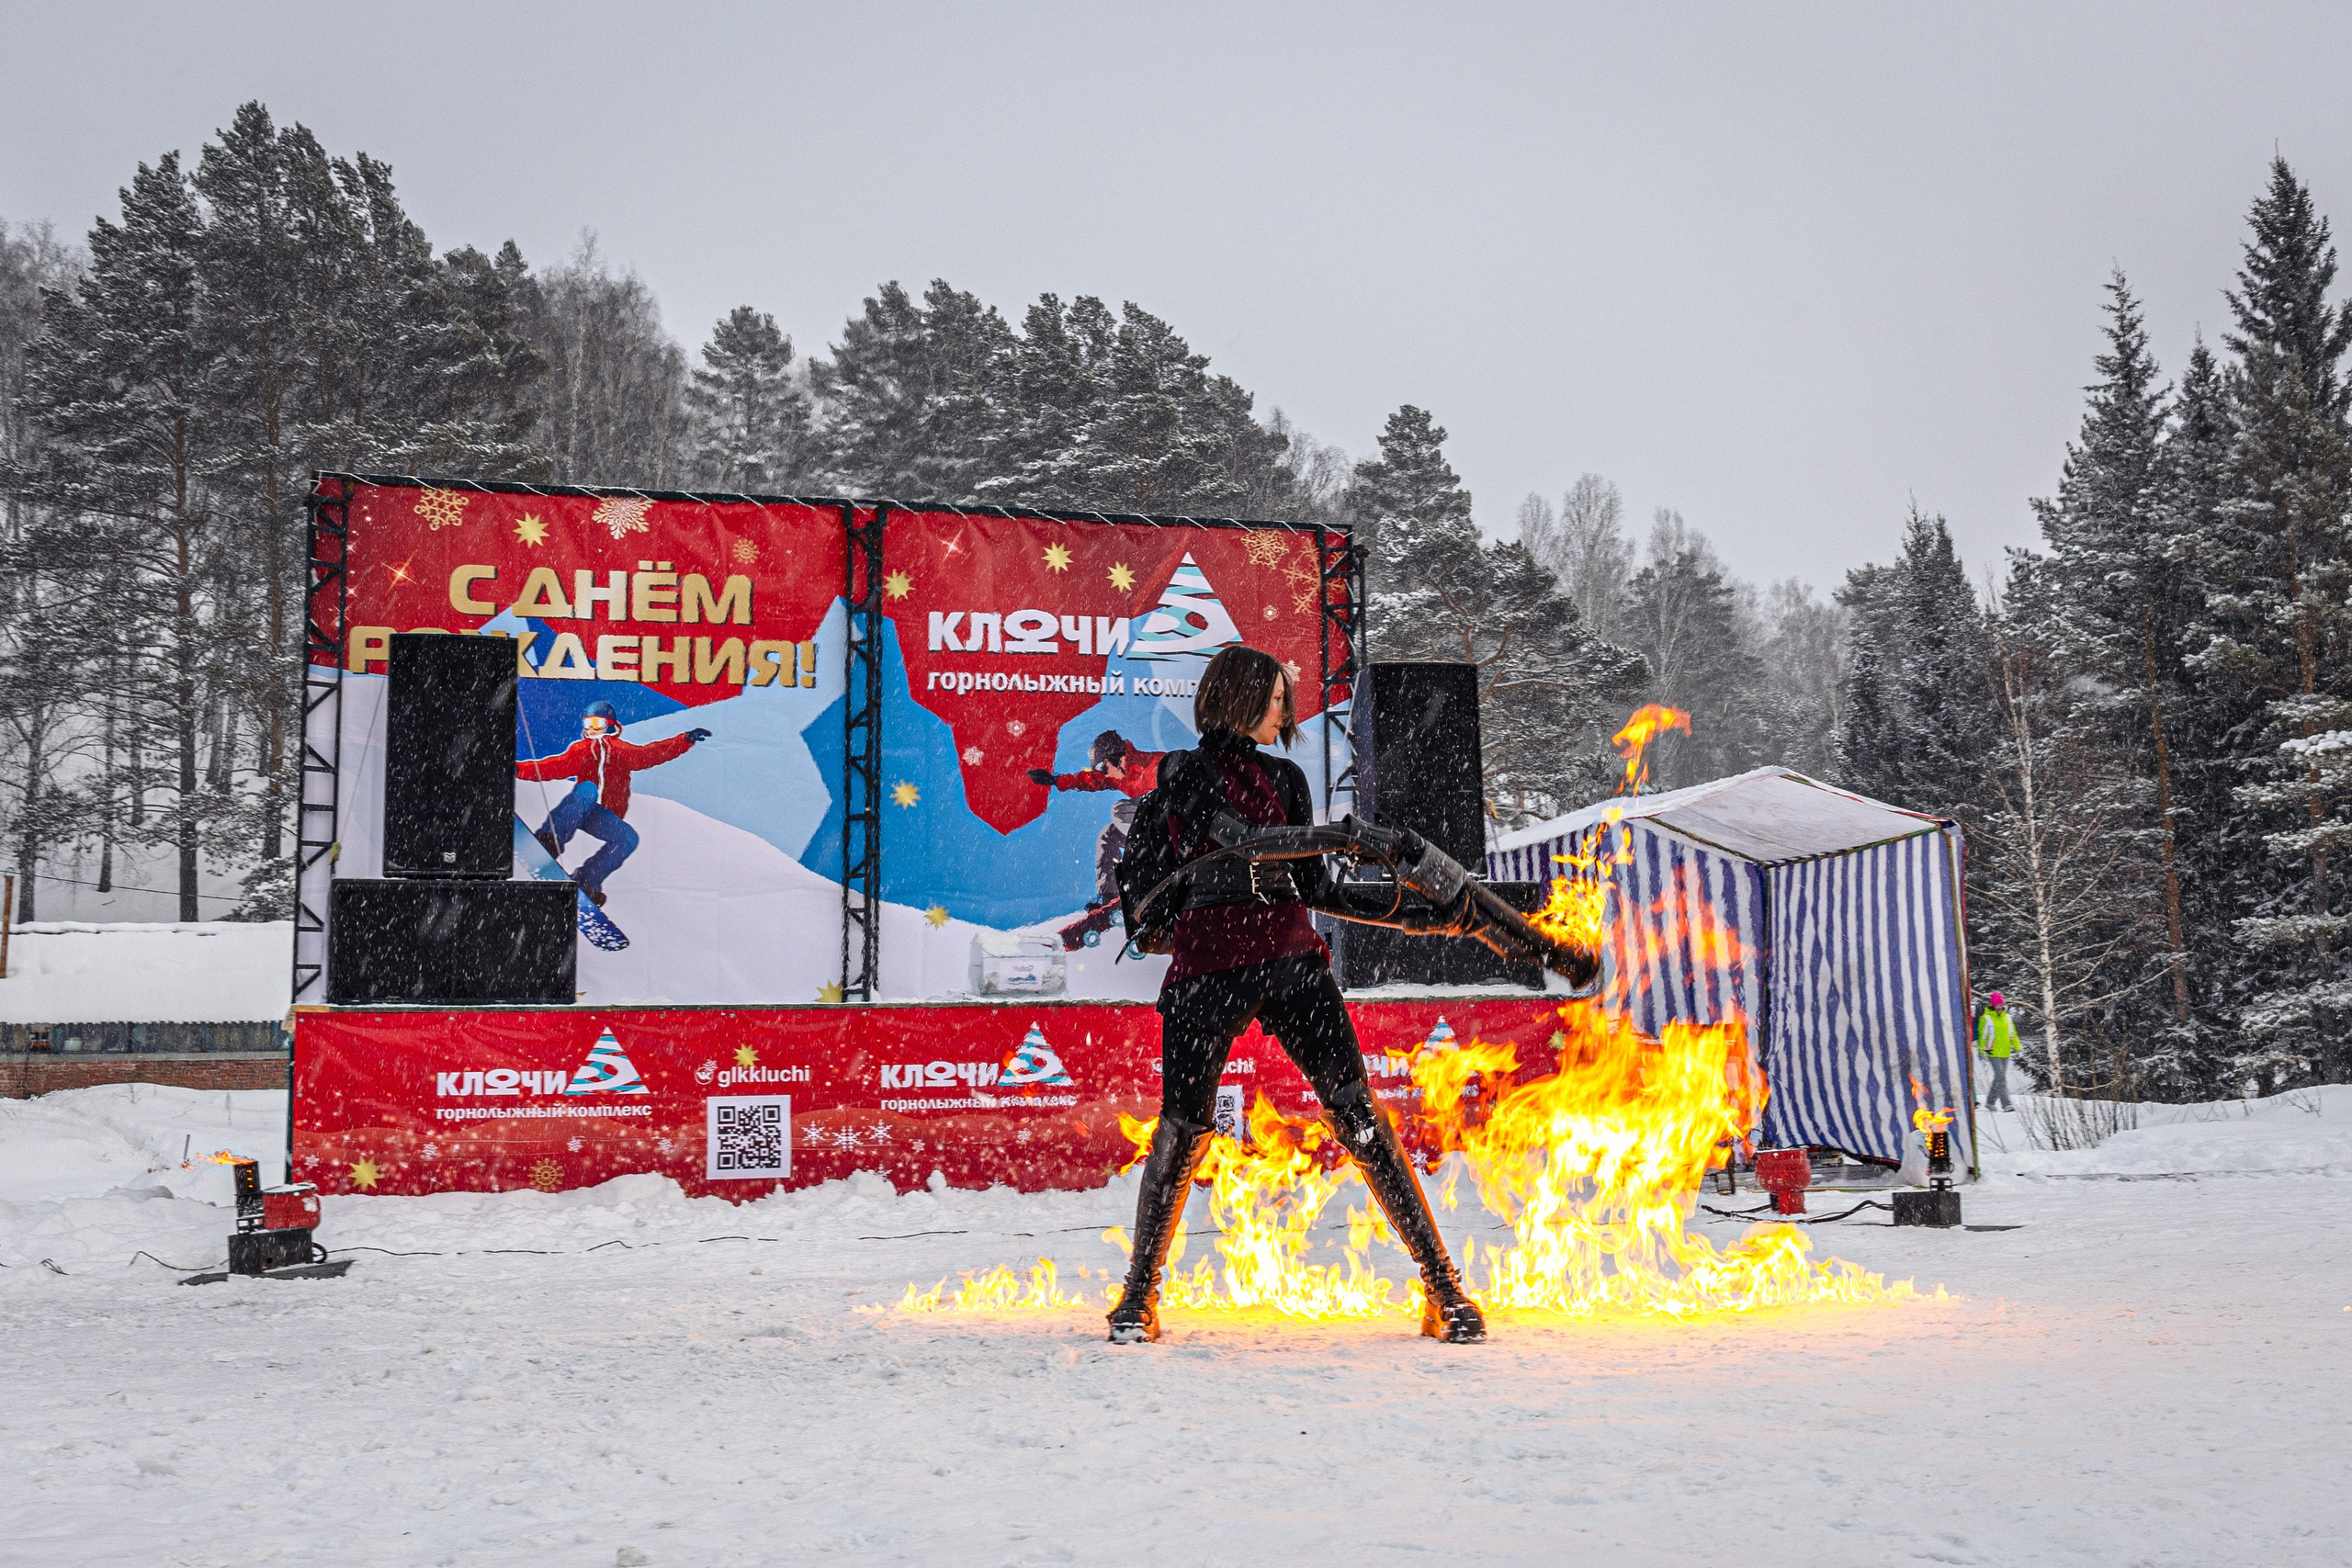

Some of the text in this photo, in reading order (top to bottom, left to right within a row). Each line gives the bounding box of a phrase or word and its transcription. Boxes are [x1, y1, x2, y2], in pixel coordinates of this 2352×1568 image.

[448, 560, 753, 625] С ДНЁМ
[349, 626, 817, 687] РДЕНИЯ!
[927, 671, 1125, 696] горнолыжный
[718, 1065, 810, 1088] glkkluchi
[435, 1103, 652, 1122] горнолыжный комплекс
